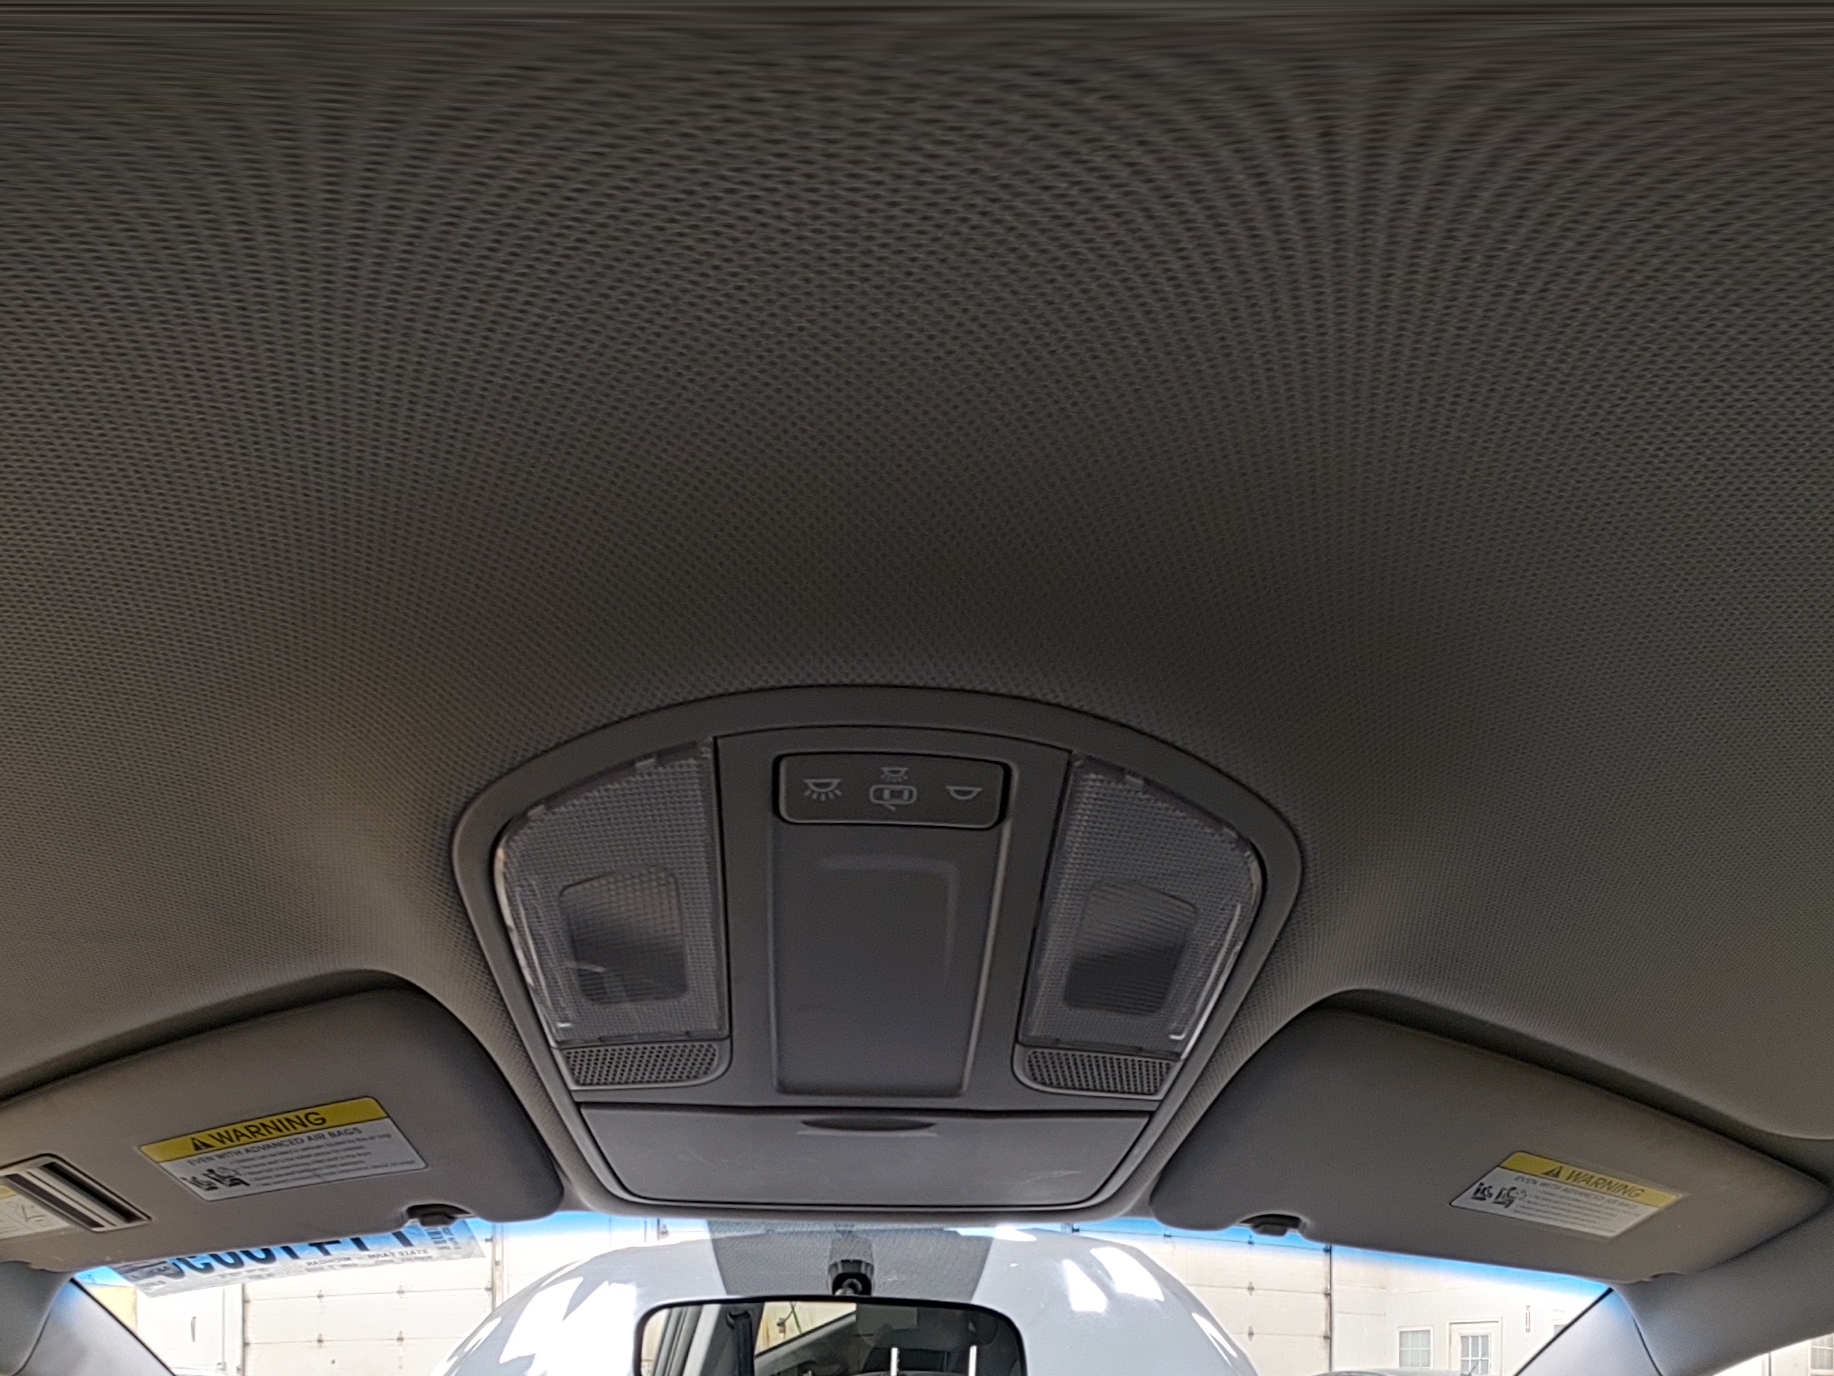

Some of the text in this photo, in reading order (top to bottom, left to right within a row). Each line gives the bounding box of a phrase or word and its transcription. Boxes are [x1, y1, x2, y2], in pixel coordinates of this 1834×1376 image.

[207, 1111, 327, 1145] WARNING
[186, 1127, 363, 1166] EVEN WITH ADVANCED AIR BAGS
[1565, 1169, 1645, 1199] WARNING
